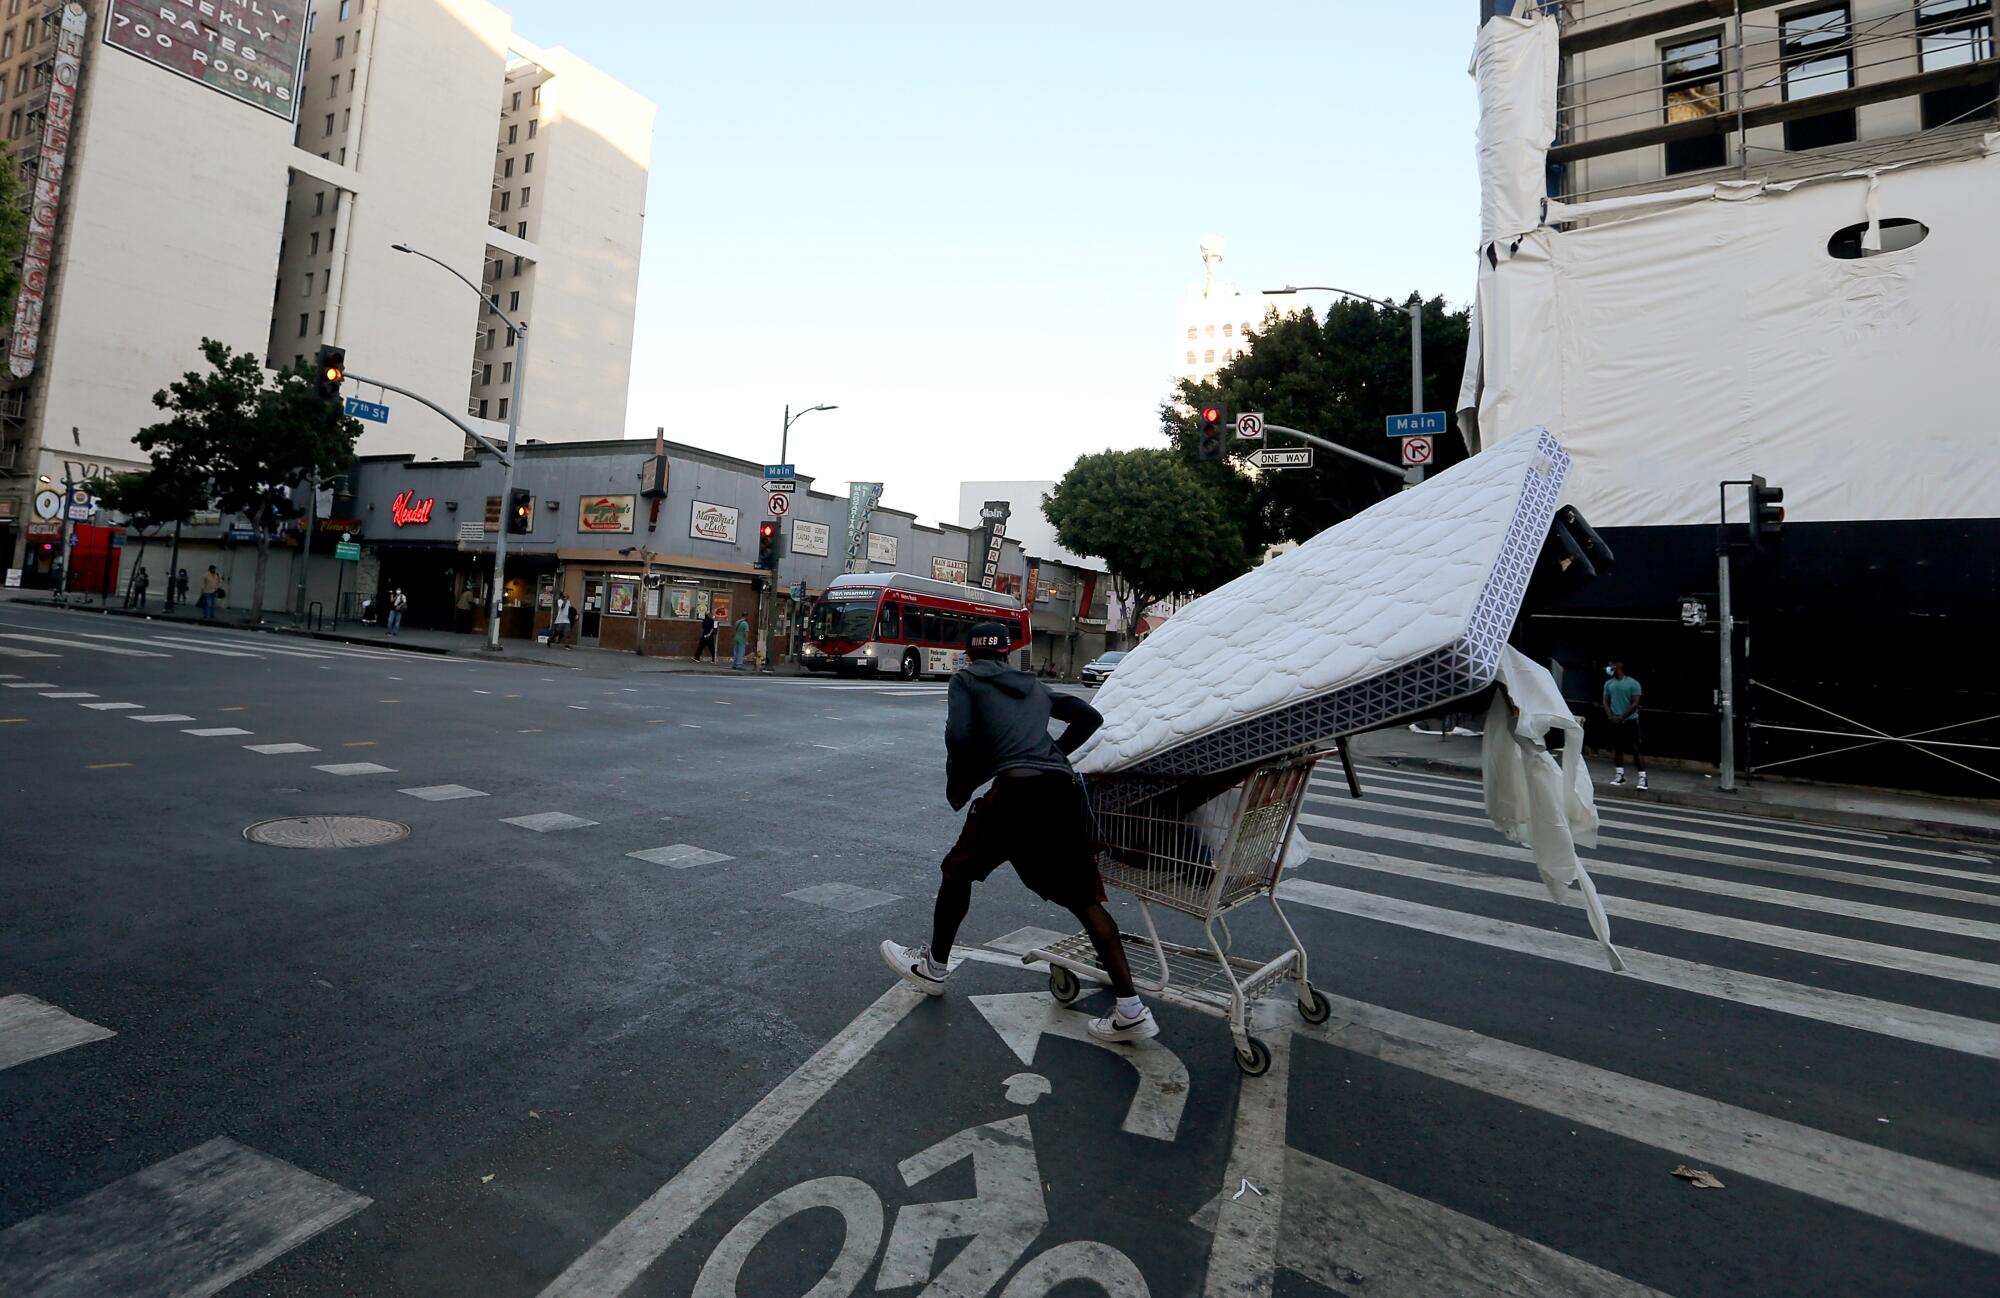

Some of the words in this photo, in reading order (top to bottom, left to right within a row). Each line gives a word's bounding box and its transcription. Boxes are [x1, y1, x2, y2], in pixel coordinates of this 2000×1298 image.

[230, 0, 286, 24] ILY
[159, 7, 257, 61] RATES
[114, 13, 173, 48] 700
[192, 49, 290, 101] ROOMS
[38, 29, 82, 184] HOTEL
[350, 402, 369, 414] 7th
[372, 408, 385, 419] St
[1397, 416, 1435, 430] Main
[1261, 453, 1280, 463] ONE
[1285, 452, 1306, 463] WAY
[769, 467, 790, 475] Main
[982, 508, 1002, 518] Main
[845, 486, 881, 570] MEXICAN
[971, 637, 987, 646] NIKE
[988, 636, 998, 645] SB
